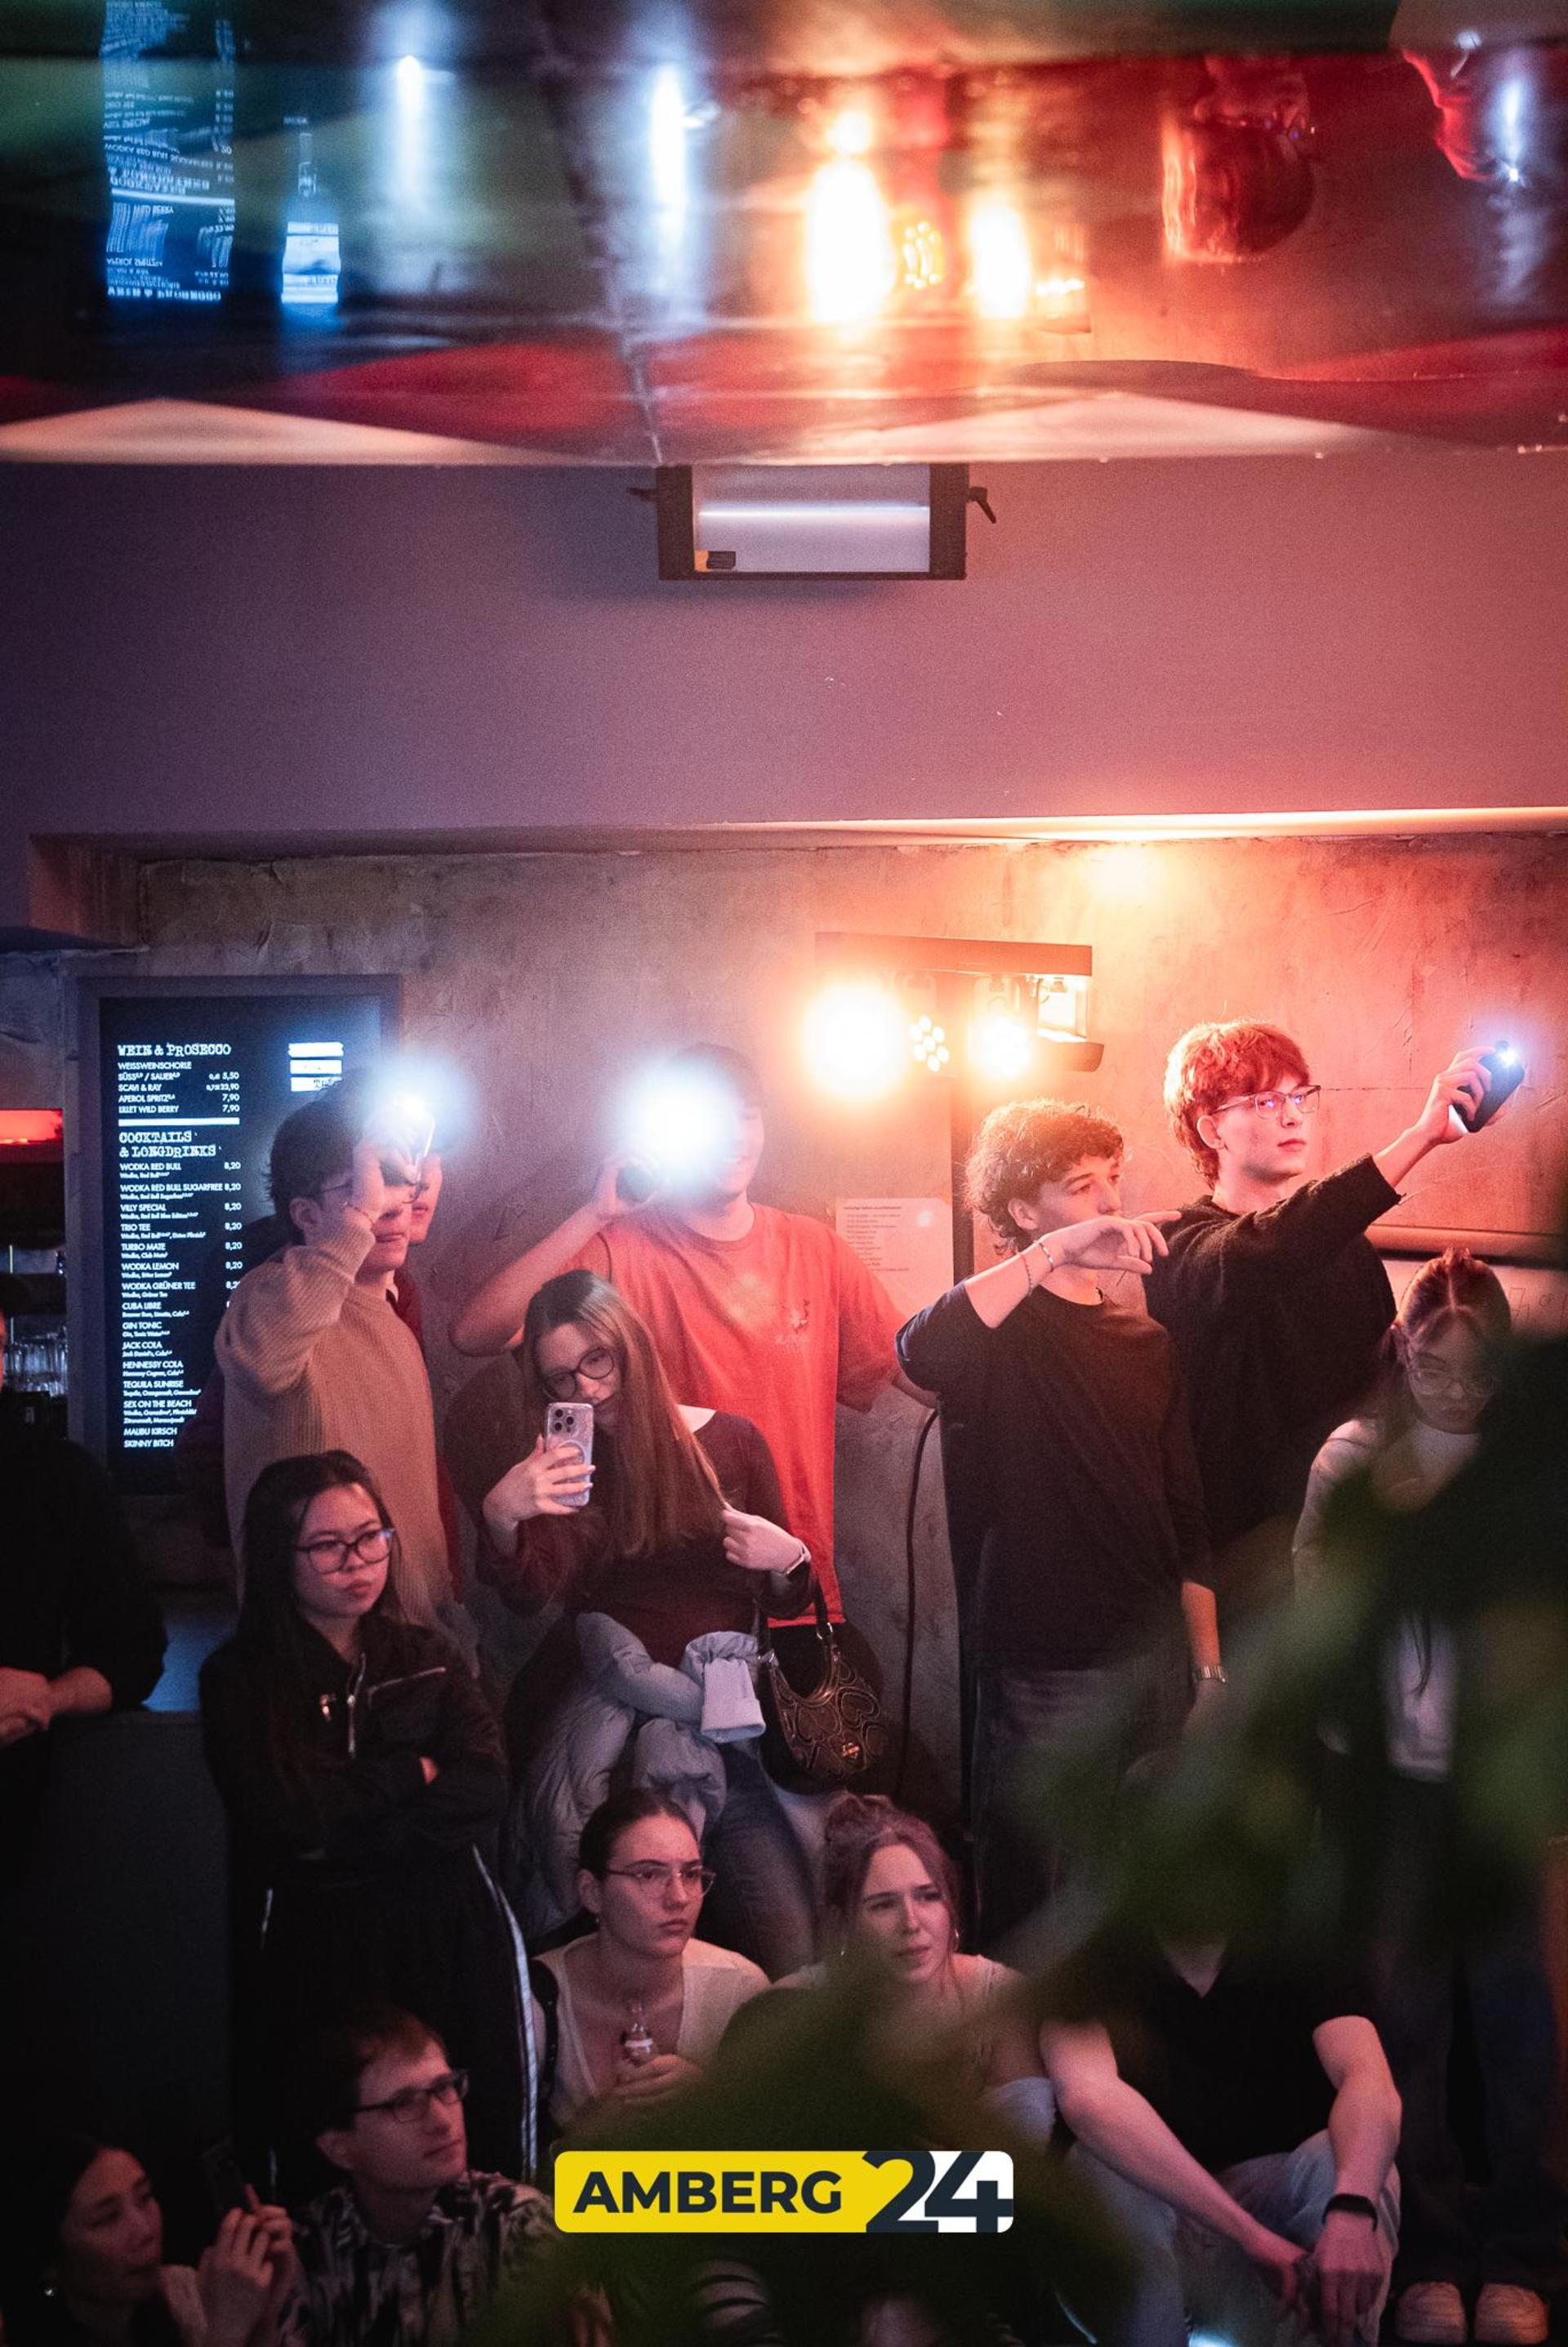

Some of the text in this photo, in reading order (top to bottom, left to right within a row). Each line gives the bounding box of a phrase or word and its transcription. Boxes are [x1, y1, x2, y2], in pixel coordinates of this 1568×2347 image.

[118, 1043, 231, 1057] WEIN & PROSECCO
[222, 1093, 239, 1102] 7,90
[222, 1105, 240, 1113] 7,90
[119, 1130, 192, 1143] COCKTAILS
[119, 1144, 216, 1158] & LONGDRINKS
[224, 1162, 241, 1170] 8,20
[225, 1182, 241, 1191] 8,20
[225, 1203, 242, 1211] 8,20
[225, 1222, 242, 1231] 8,20
[225, 1242, 243, 1250] 8,20
[225, 1262, 243, 1270] 8,20
[153, 1281, 182, 1289] GRÜNER
[225, 1281, 240, 1289] 8,2
[142, 1341, 163, 1349] COLA
